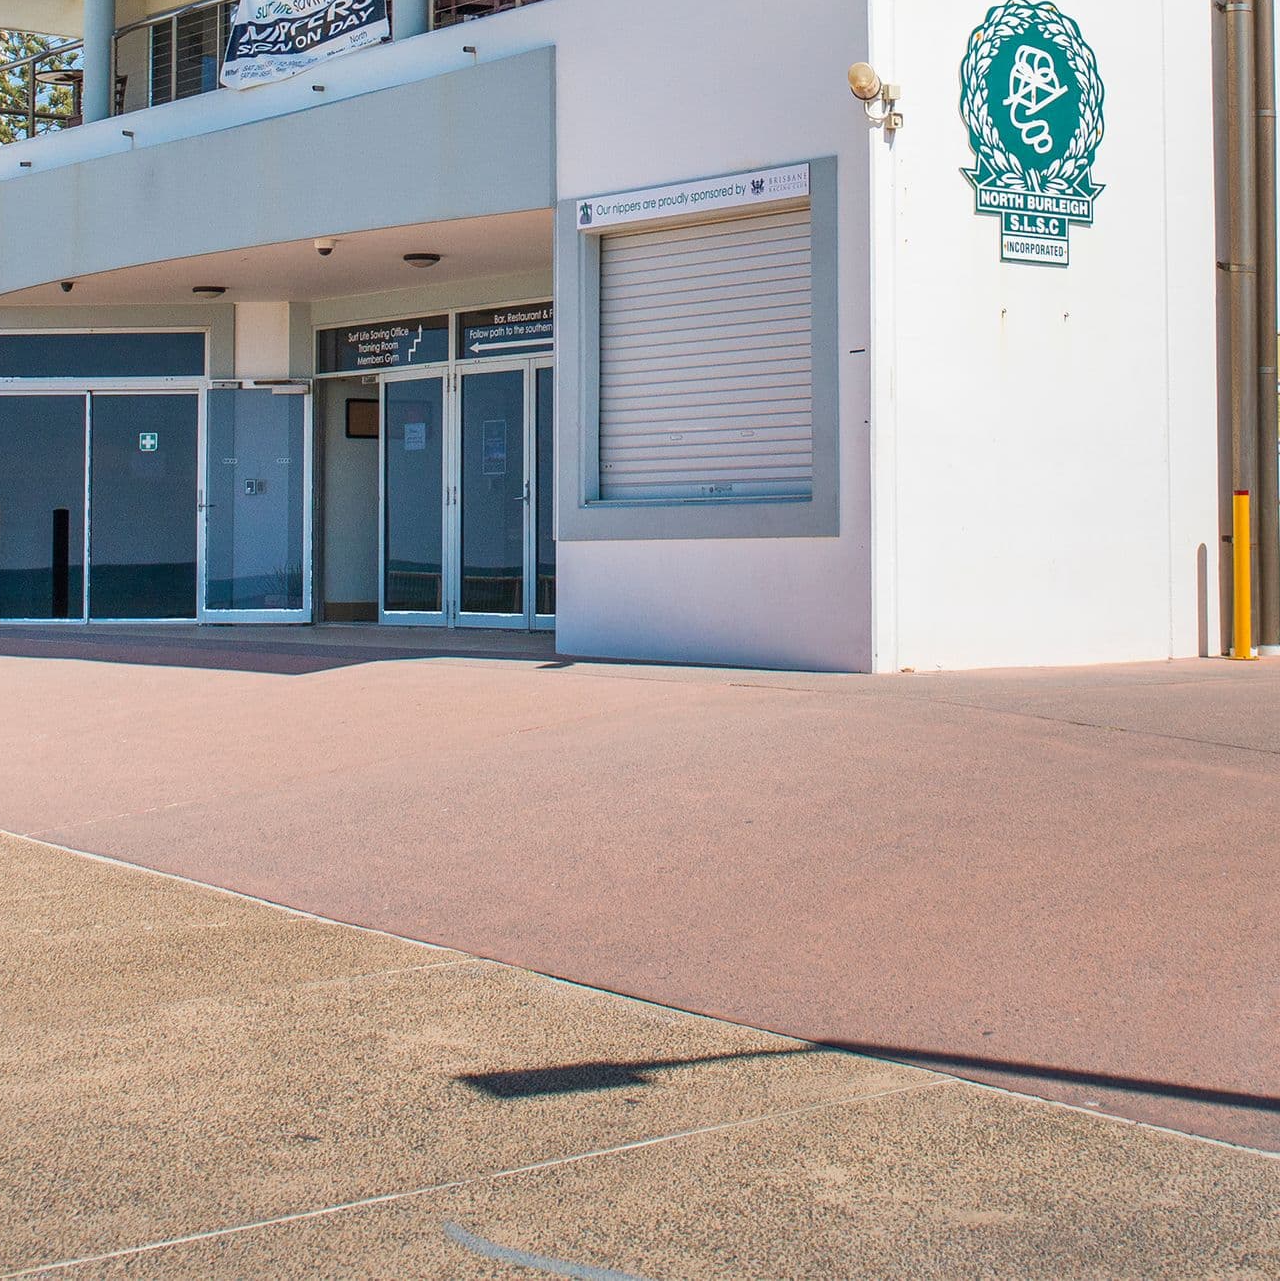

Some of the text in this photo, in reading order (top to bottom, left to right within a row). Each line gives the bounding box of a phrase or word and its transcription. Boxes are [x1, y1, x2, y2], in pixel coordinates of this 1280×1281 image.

[295, 27, 322, 49] ON
[327, 6, 375, 37] DAY
[596, 183, 747, 216] Our nippers are proudly sponsored by
[981, 190, 1089, 216] NORTH BURLEIGH
[1006, 240, 1064, 257] INCORPORATED
[507, 310, 541, 322] Restaurant
[348, 327, 410, 343] Surf Life Saving Office
[470, 329, 489, 339] Follow
[489, 327, 505, 338] path
[506, 327, 513, 335] to
[513, 325, 524, 334] the
[358, 341, 399, 353] Training Room
[357, 353, 400, 366] Members Gym
